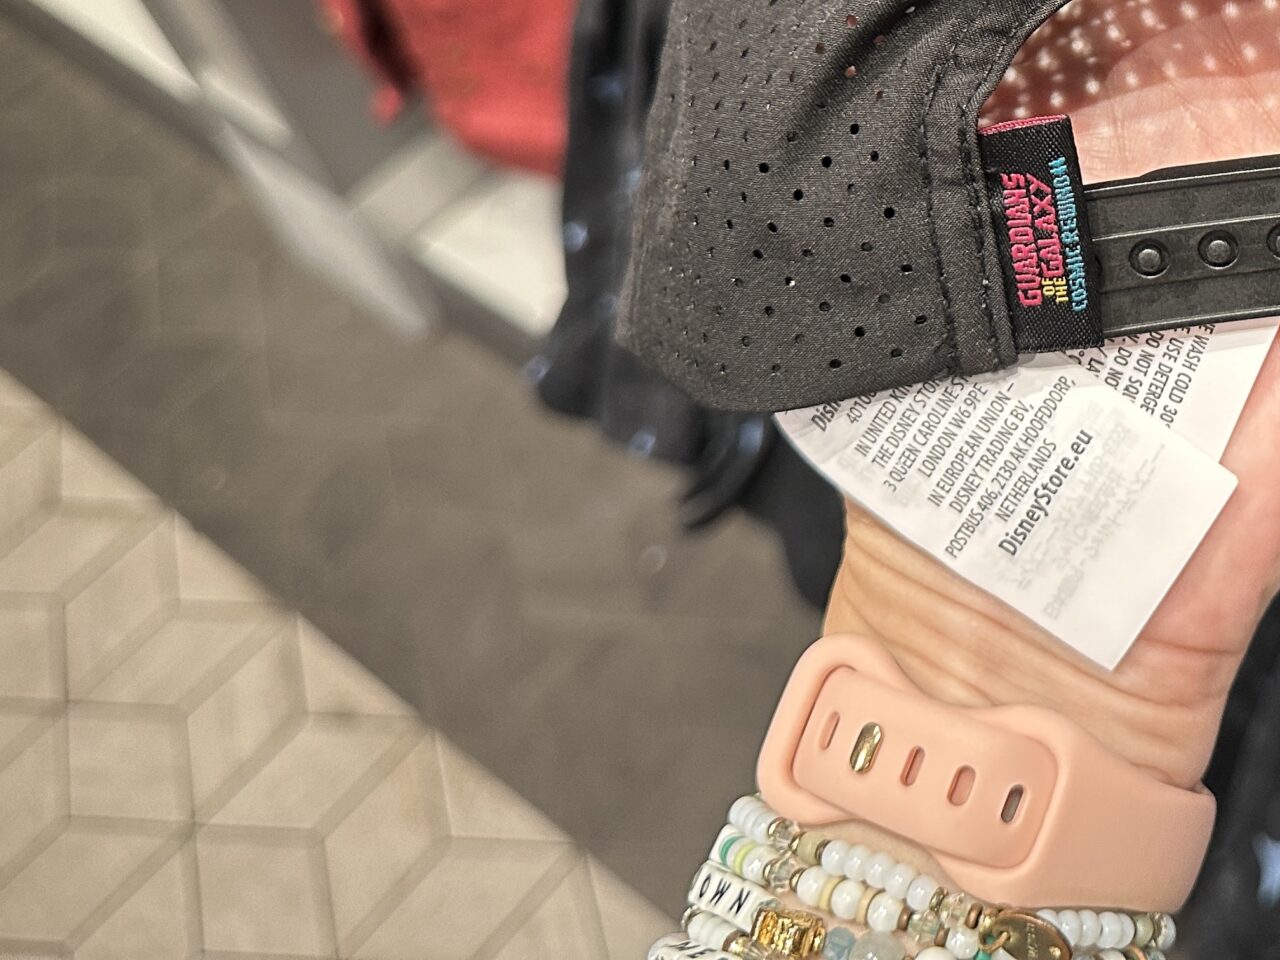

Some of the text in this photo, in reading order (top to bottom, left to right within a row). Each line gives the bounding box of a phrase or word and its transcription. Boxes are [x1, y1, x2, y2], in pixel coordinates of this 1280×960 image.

[1000, 173, 1043, 308] GUARDIANS
[1026, 173, 1065, 279] GALAXY
[1052, 174, 1089, 313] COSMIC REWIND
[1041, 276, 1056, 298] OF
[1053, 276, 1069, 305] THE
[1113, 346, 1133, 367] DO
[1145, 331, 1165, 349] DO
[1162, 336, 1184, 363] USE
[1181, 334, 1210, 372] WASH
[1086, 357, 1105, 378] LA
[1104, 367, 1124, 391] NO
[1133, 349, 1156, 377] NOT
[1140, 362, 1173, 416] DETERGE
[1168, 372, 1192, 404] COLD
[862, 401, 897, 444] UNITED
[913, 385, 960, 447] CAROLINE
[917, 382, 989, 478] LONDON W6 9PE
[976, 391, 1012, 434] UNION
[1018, 376, 1077, 448] HOOFDDORP,
[854, 440, 872, 457] IN
[872, 446, 896, 469] THE
[886, 403, 921, 449] DISNEY
[1009, 441, 1029, 464] AK
[889, 443, 922, 483] QUEEN
[936, 430, 985, 494] EUROPEAN
[949, 400, 1035, 514] DISNEY TRADING BV,
[991, 458, 1017, 491] 2130
[883, 479, 898, 493] 3
[927, 488, 946, 508] IN
[976, 487, 1003, 513] 406,
[994, 437, 1057, 523] NETHERLANDS
[998, 429, 1094, 557] DisneyStore.eu
[944, 507, 985, 559] POSTBUS
[698, 873, 752, 915] OWN
